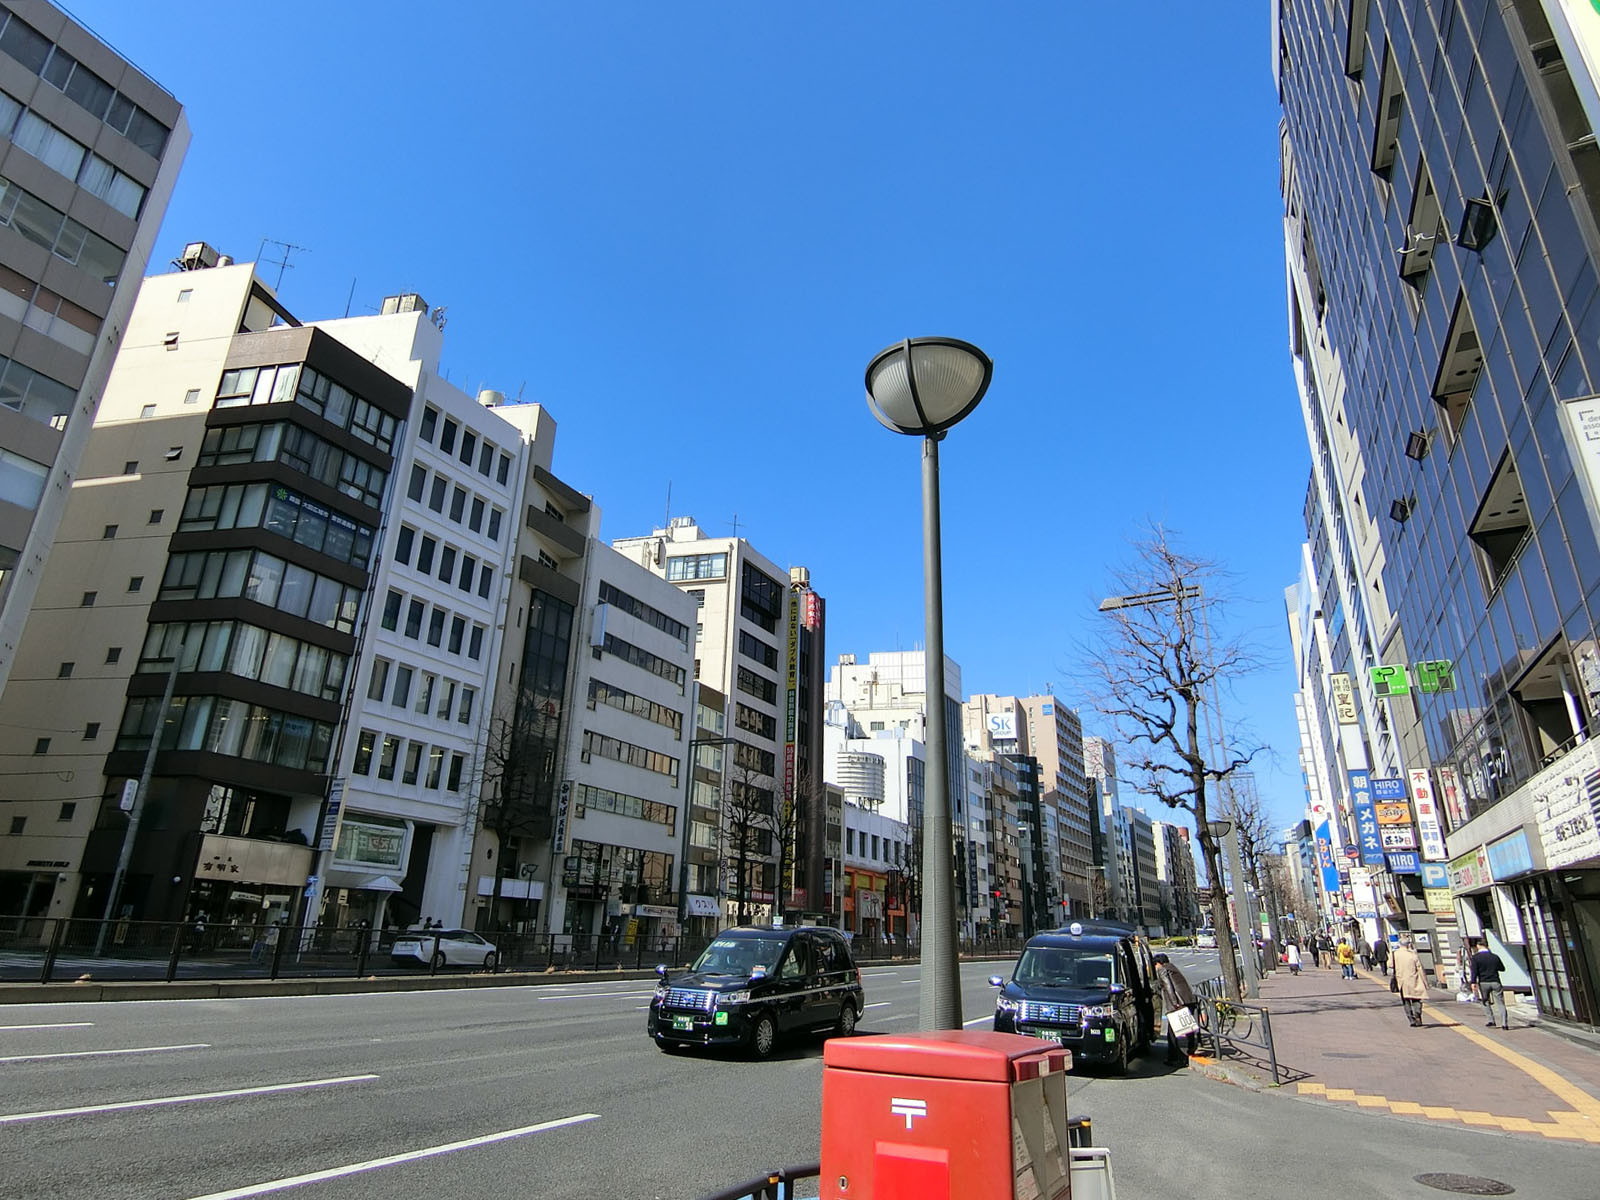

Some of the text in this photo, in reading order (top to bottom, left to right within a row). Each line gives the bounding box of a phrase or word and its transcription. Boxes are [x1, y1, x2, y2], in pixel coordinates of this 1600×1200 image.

[991, 716, 1011, 731] SK
[1374, 780, 1400, 789] HIRO
[1412, 772, 1431, 814] 不動産
[1352, 776, 1379, 850] 朝倉メガネ
[1388, 854, 1415, 866] HIRO
[1425, 866, 1444, 885] P
